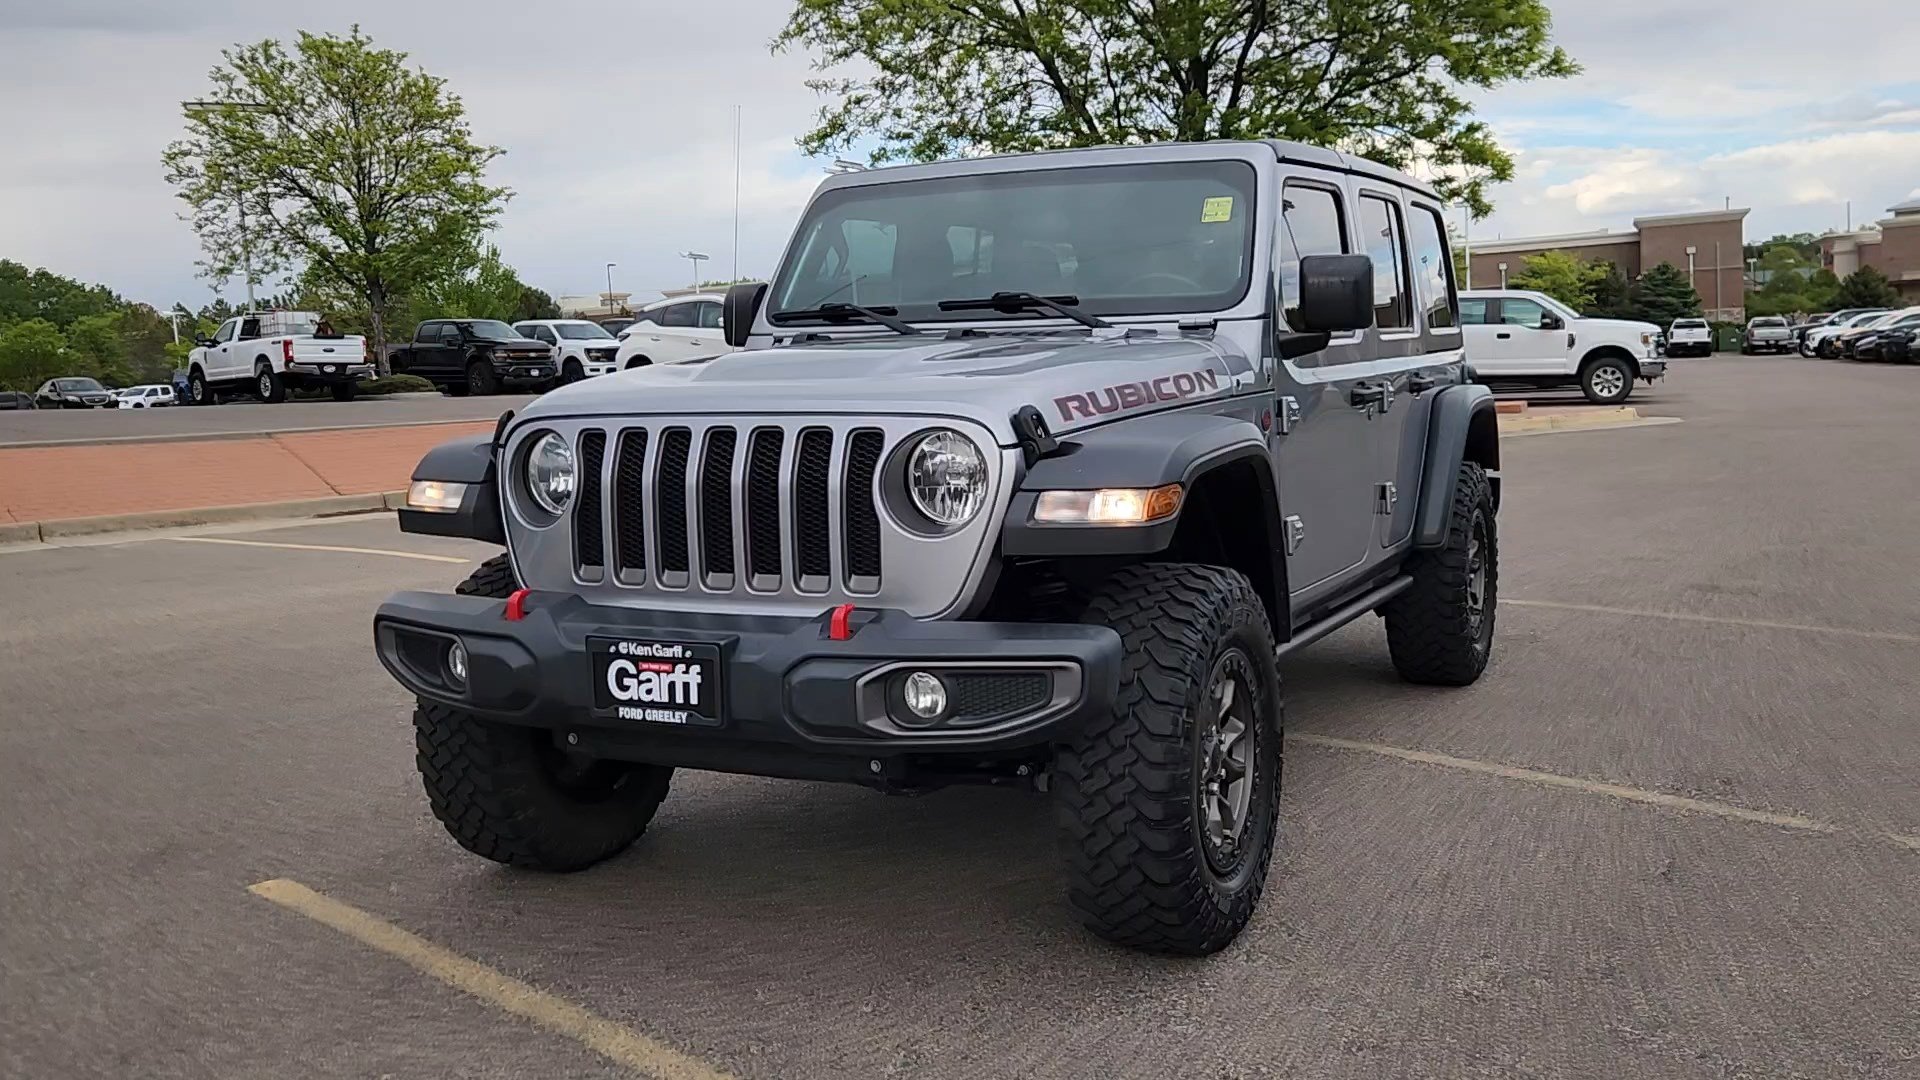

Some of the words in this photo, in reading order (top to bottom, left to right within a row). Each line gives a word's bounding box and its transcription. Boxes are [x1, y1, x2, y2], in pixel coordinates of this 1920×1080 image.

[1054, 368, 1218, 422] RUBICON
[628, 642, 652, 656] Ken
[652, 644, 683, 658] Garff
[607, 659, 701, 705] Garff
[618, 707, 643, 720] FORD
[645, 709, 688, 724] GREELEY
